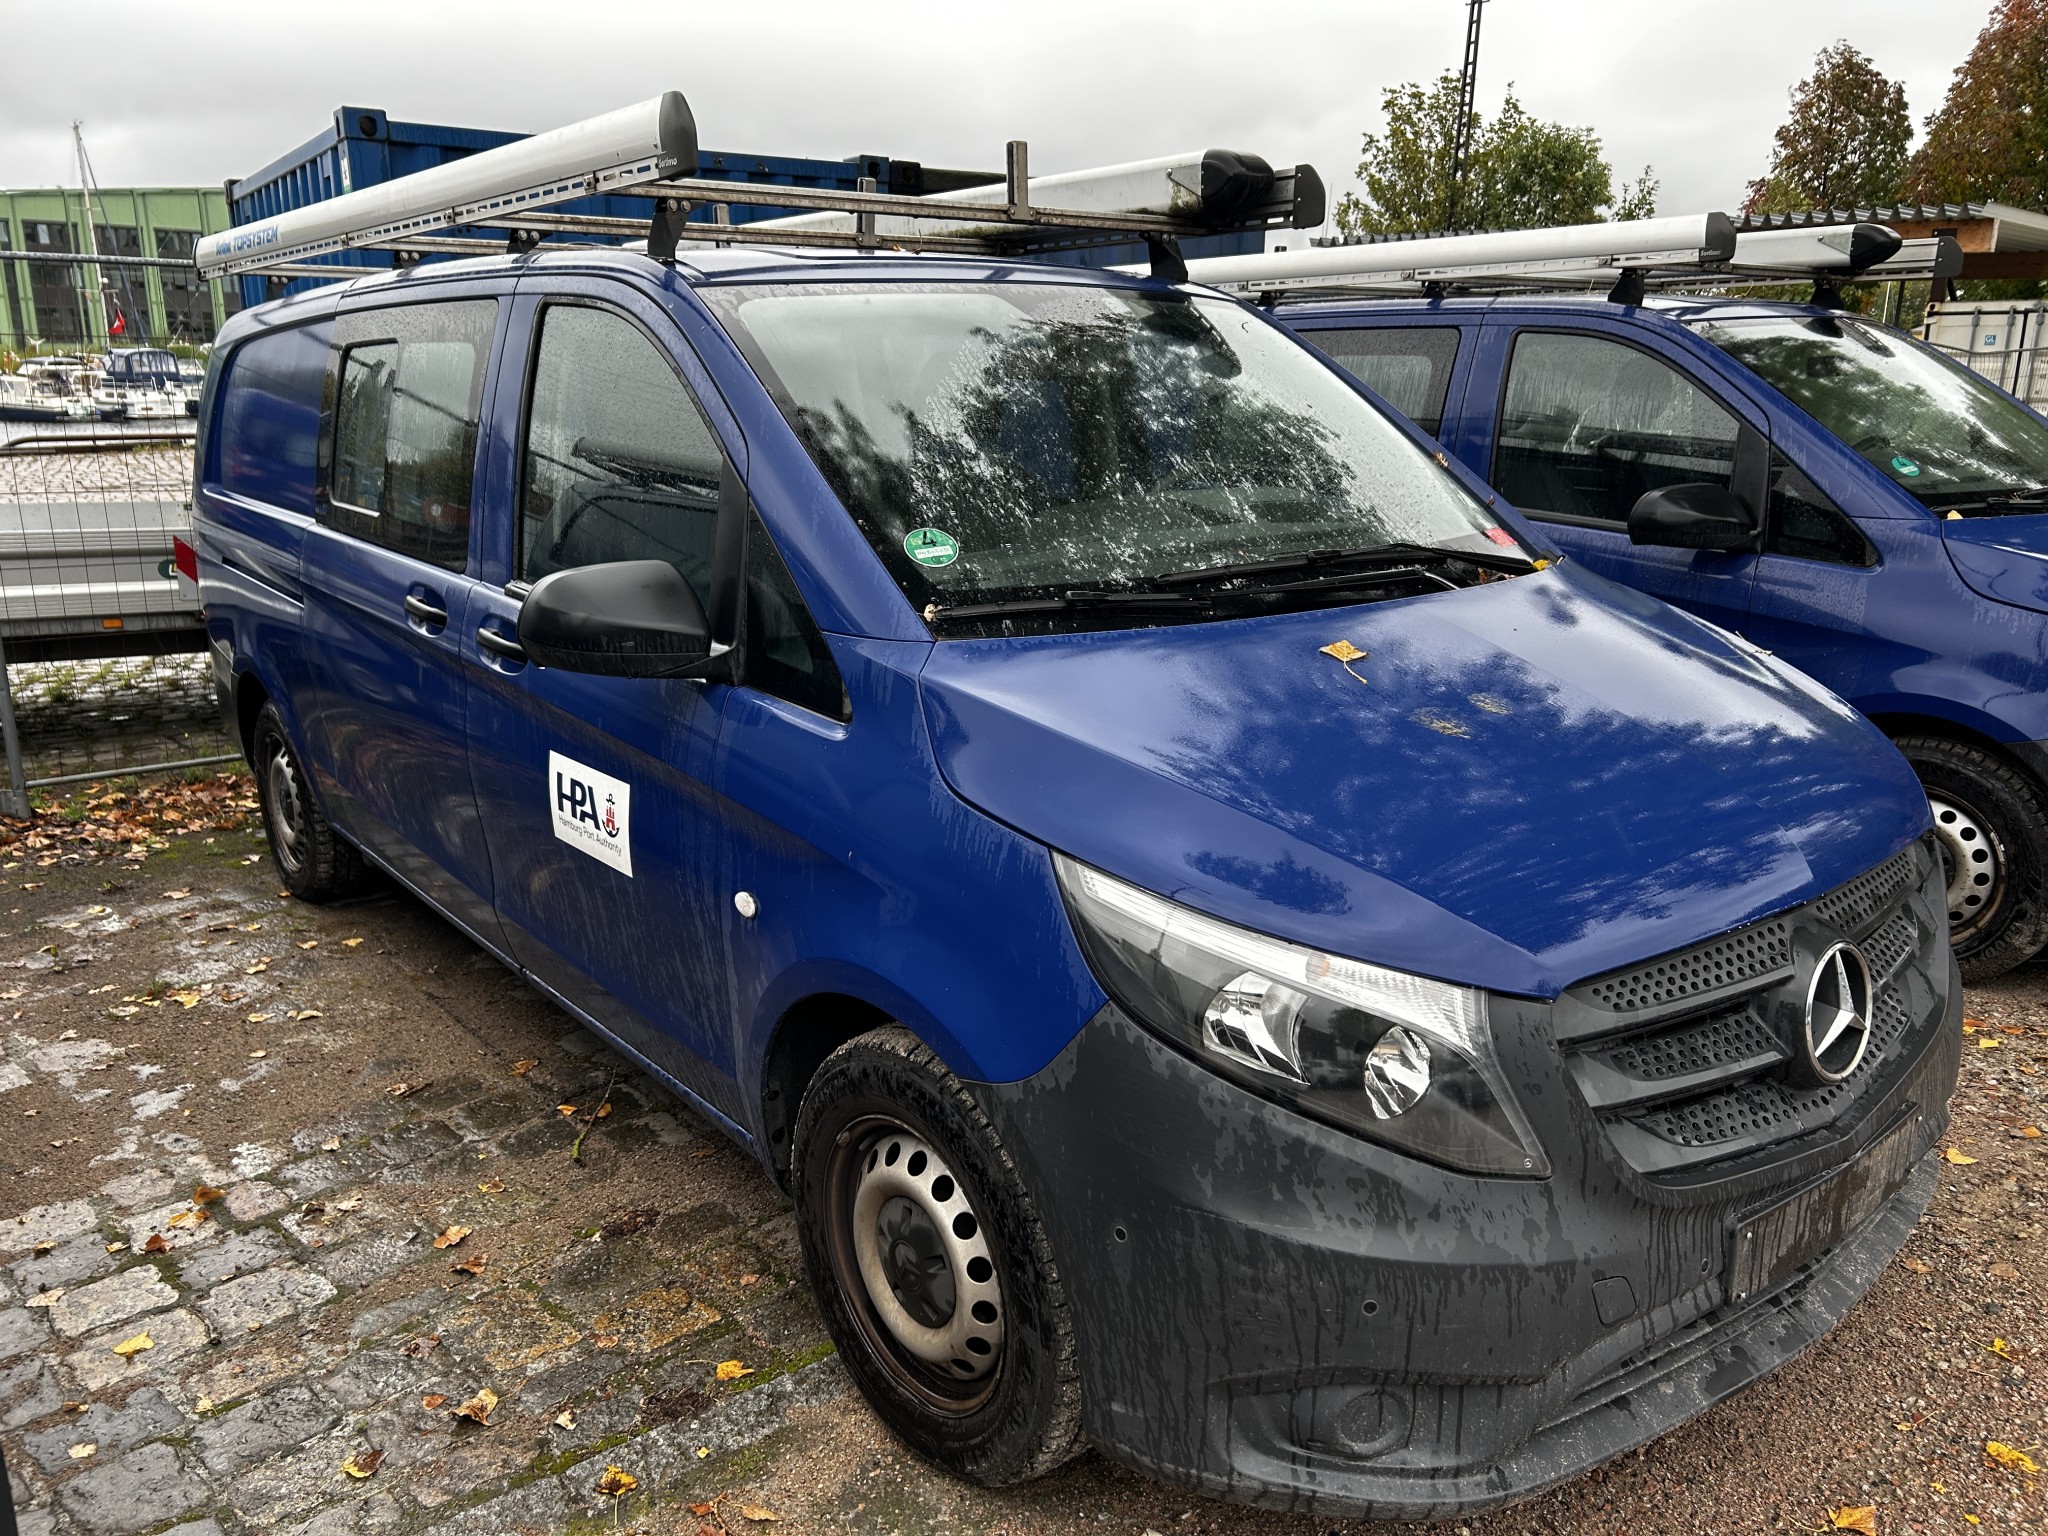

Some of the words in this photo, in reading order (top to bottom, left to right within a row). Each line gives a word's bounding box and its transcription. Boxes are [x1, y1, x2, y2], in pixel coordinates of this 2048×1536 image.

[233, 223, 279, 252] TOPSYSTEM
[557, 771, 602, 832] HPA
[559, 813, 583, 838] Hamburg
[583, 826, 596, 842] Port
[596, 834, 622, 857] Authority
